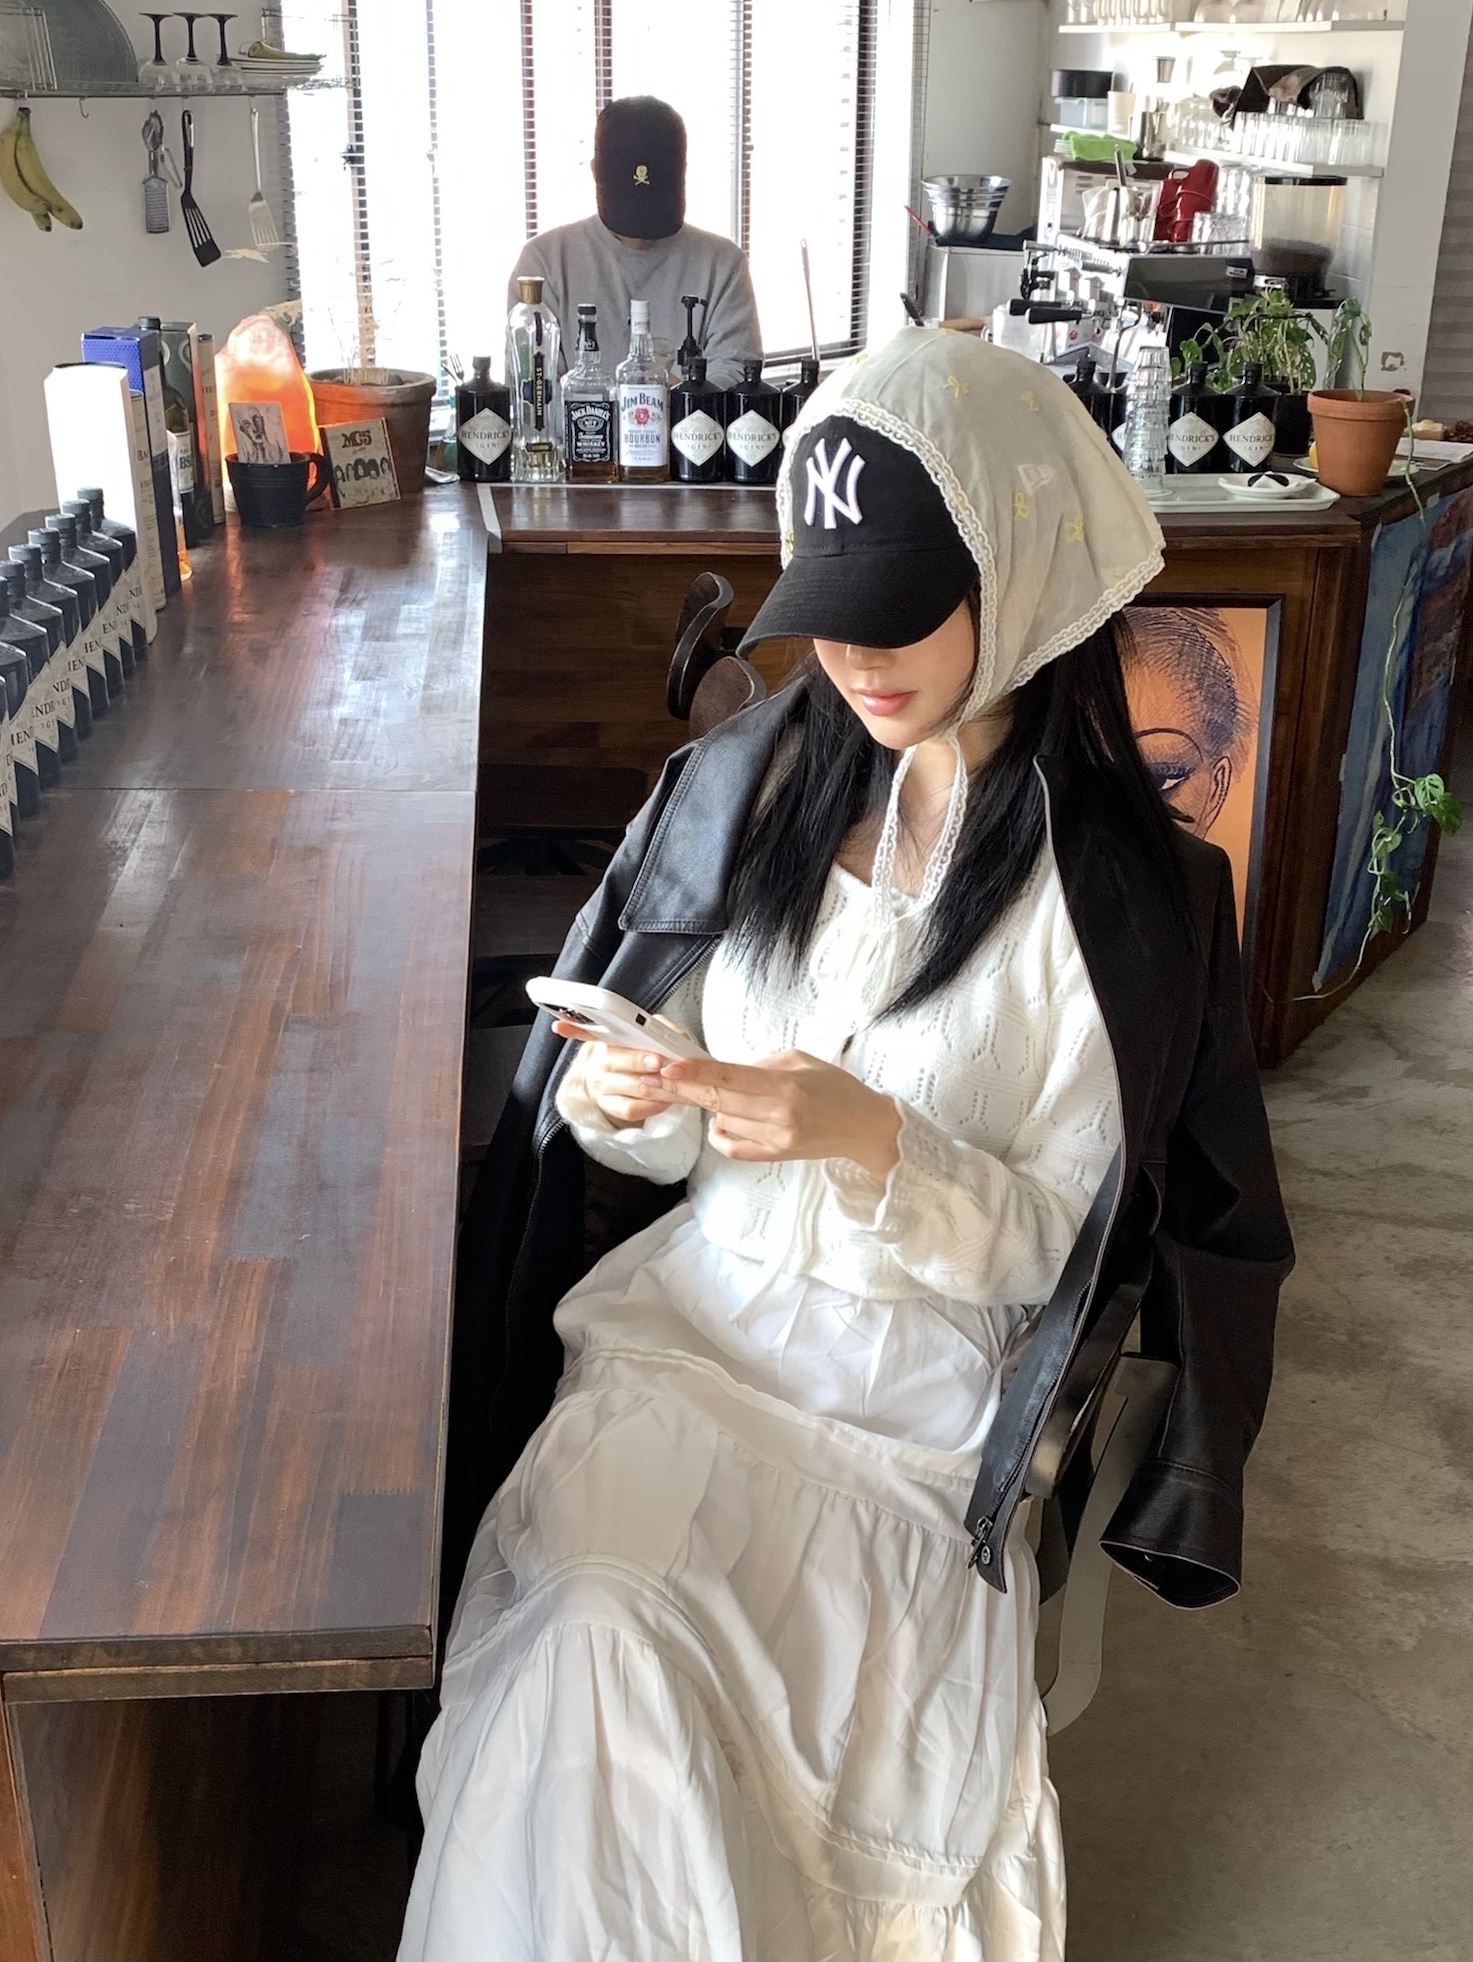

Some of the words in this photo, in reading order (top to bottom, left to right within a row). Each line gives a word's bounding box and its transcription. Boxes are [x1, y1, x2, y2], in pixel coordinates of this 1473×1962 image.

[621, 396, 638, 411] JIM
[639, 392, 664, 411] BEAM
[571, 407, 586, 421] JACK
[341, 429, 372, 448] MC5
[624, 434, 661, 443] BOURBON
[804, 437, 866, 529] NY
